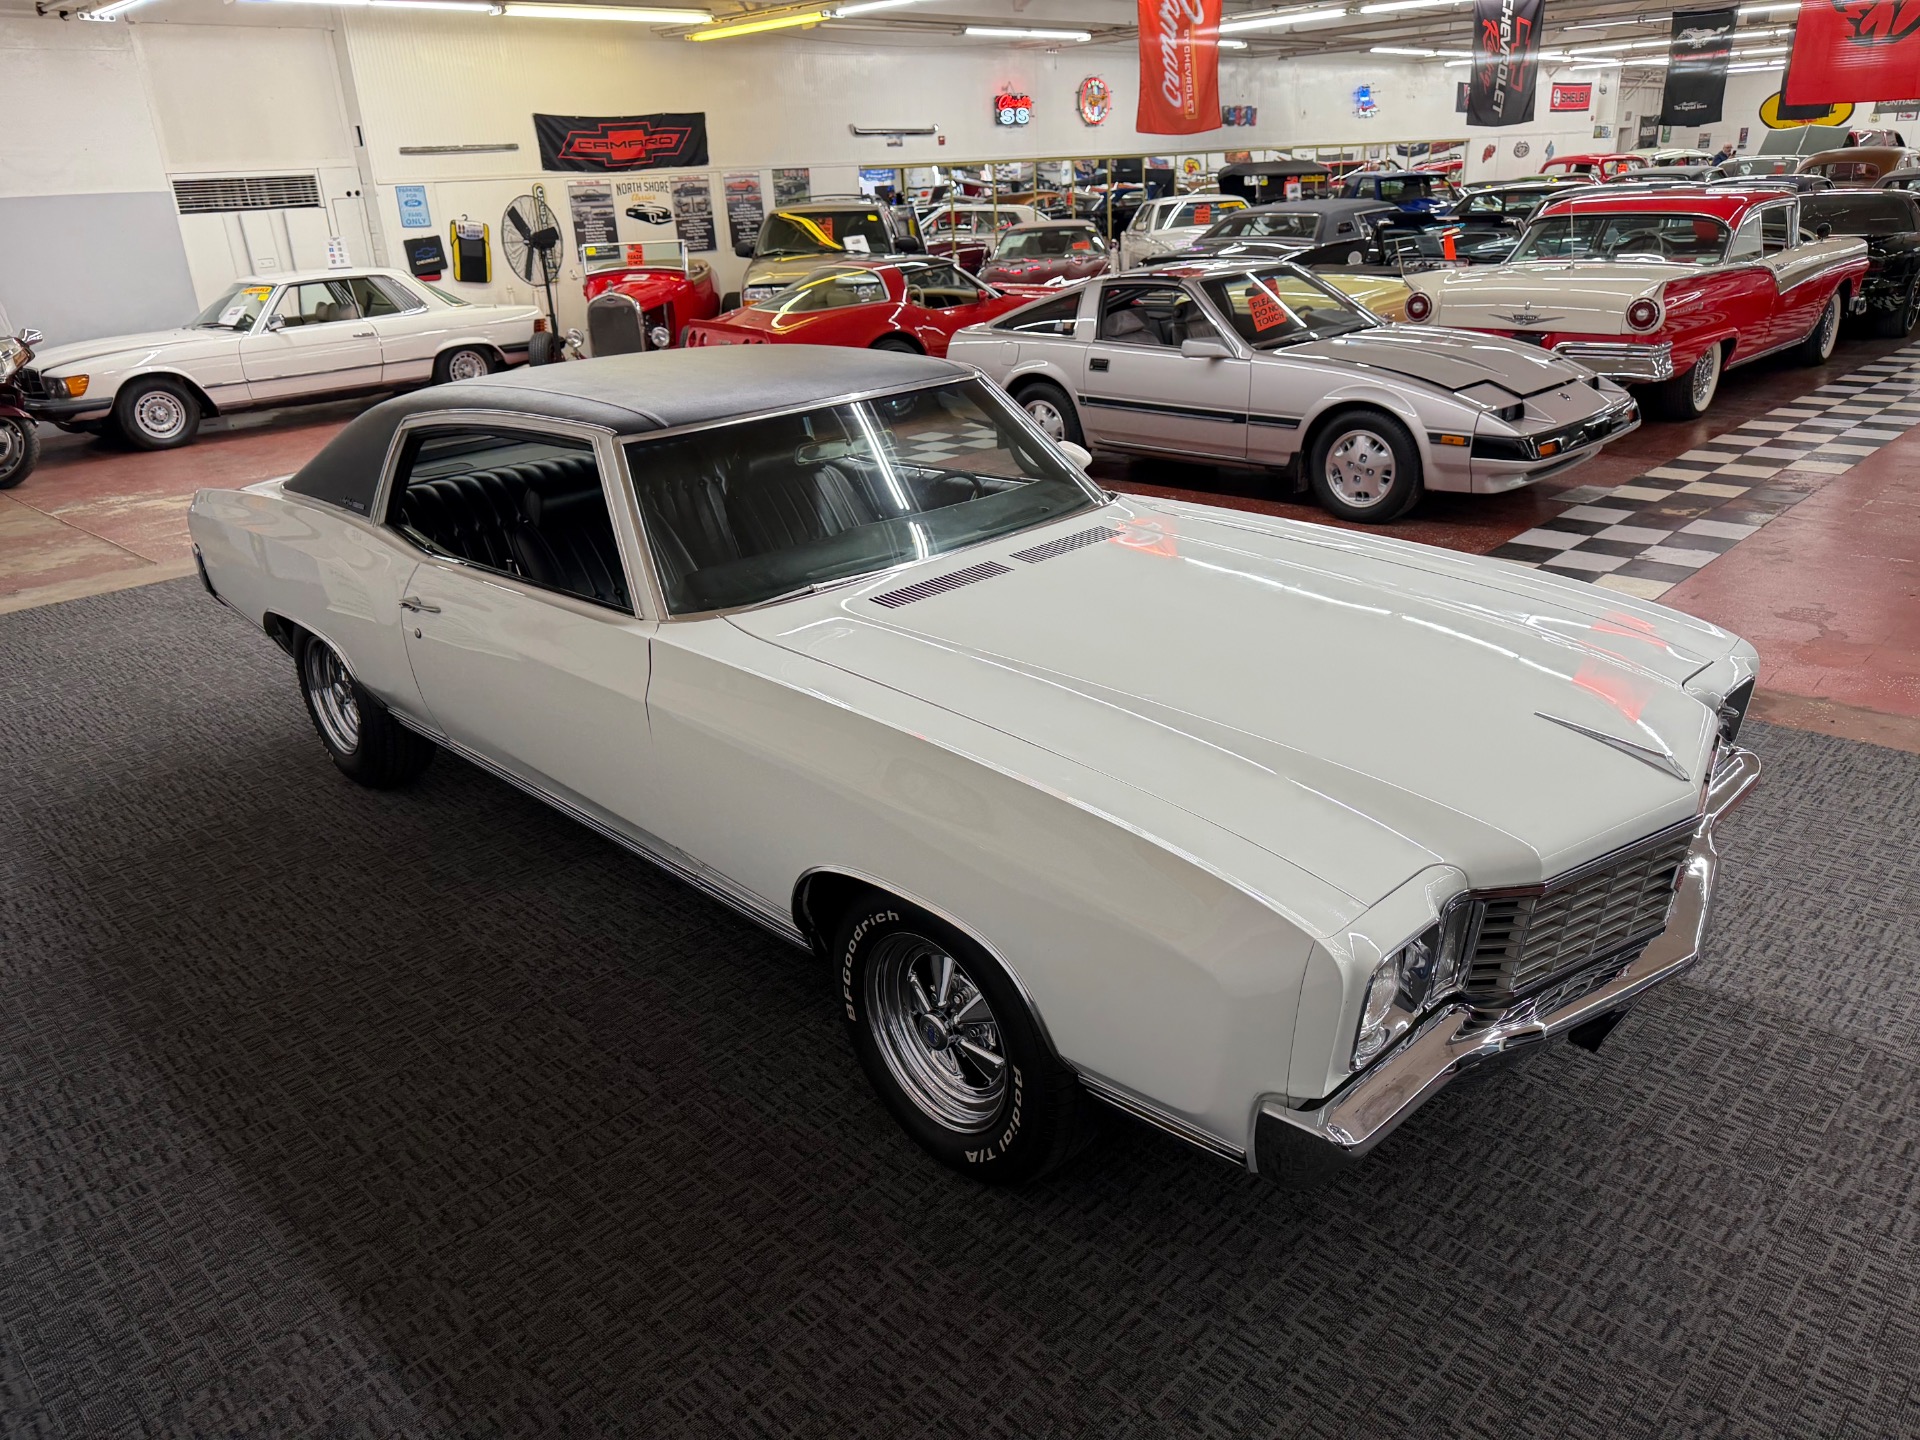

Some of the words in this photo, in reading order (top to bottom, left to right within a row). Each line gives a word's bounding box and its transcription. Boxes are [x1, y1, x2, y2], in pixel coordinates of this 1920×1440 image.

[1492, 0, 1514, 118] CHEVROLET
[1184, 46, 1195, 114] CHEVROLET
[1561, 91, 1589, 103] SHELBY
[1000, 107, 1030, 125] SS
[577, 136, 673, 150] CAMARO
[616, 182, 642, 196] NORTH
[644, 181, 670, 194] SHORE
[1254, 308, 1268, 318] DO
[1257, 312, 1284, 326] TOUCH
[842, 910, 900, 1022] BFGoodrich
[998, 1064, 1023, 1152] Radial
[964, 1147, 997, 1163] T/A
